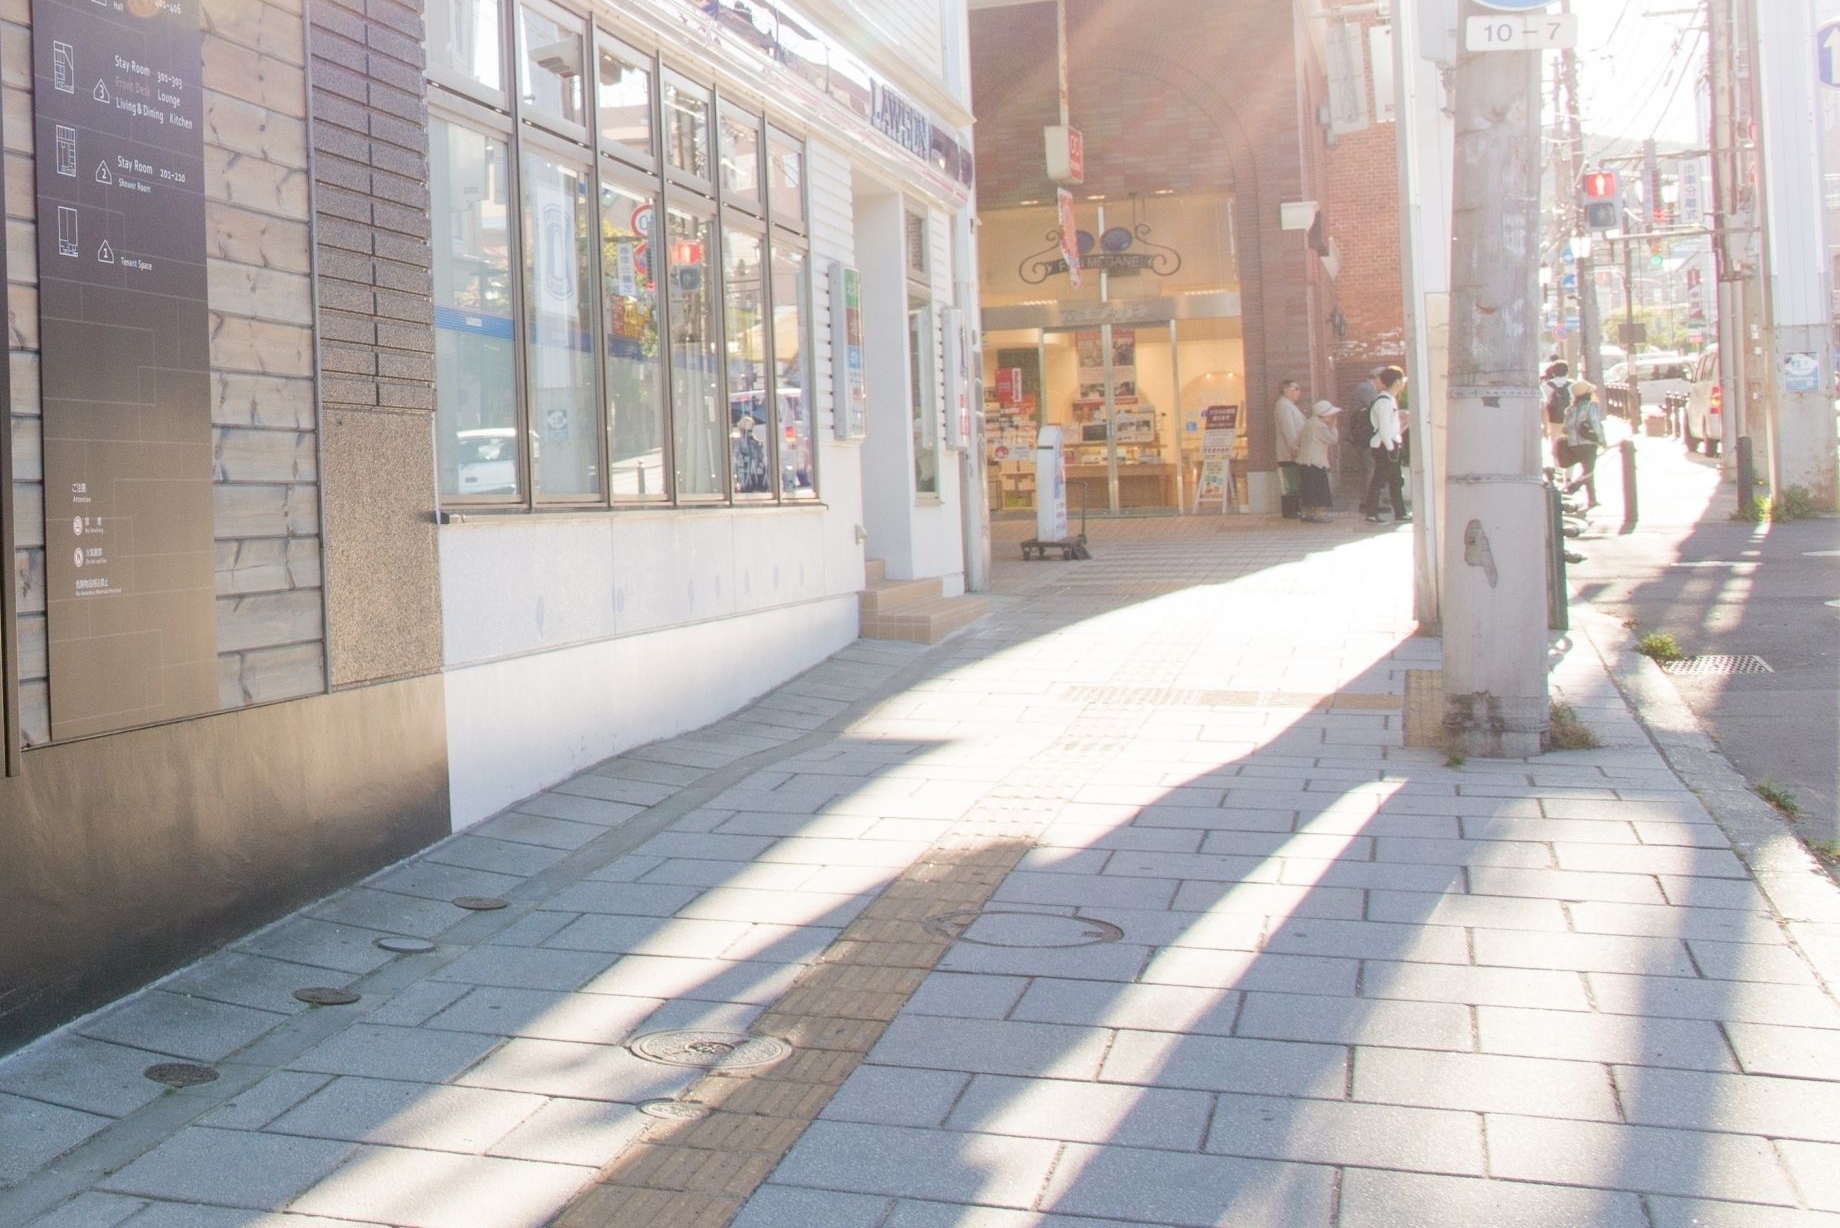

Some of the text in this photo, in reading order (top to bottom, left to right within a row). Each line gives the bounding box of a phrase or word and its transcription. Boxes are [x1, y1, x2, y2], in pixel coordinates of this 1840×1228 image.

[114, 54, 130, 73] Stay
[131, 60, 151, 77] Room
[99, 85, 105, 99] 3
[157, 90, 181, 109] Lounge
[169, 114, 193, 130] Kitchen
[117, 155, 133, 171] Stay
[134, 159, 153, 175] Room
[101, 168, 107, 180] 2
[118, 178, 151, 193] Shower Room
[120, 257, 153, 272] Tenant Space
